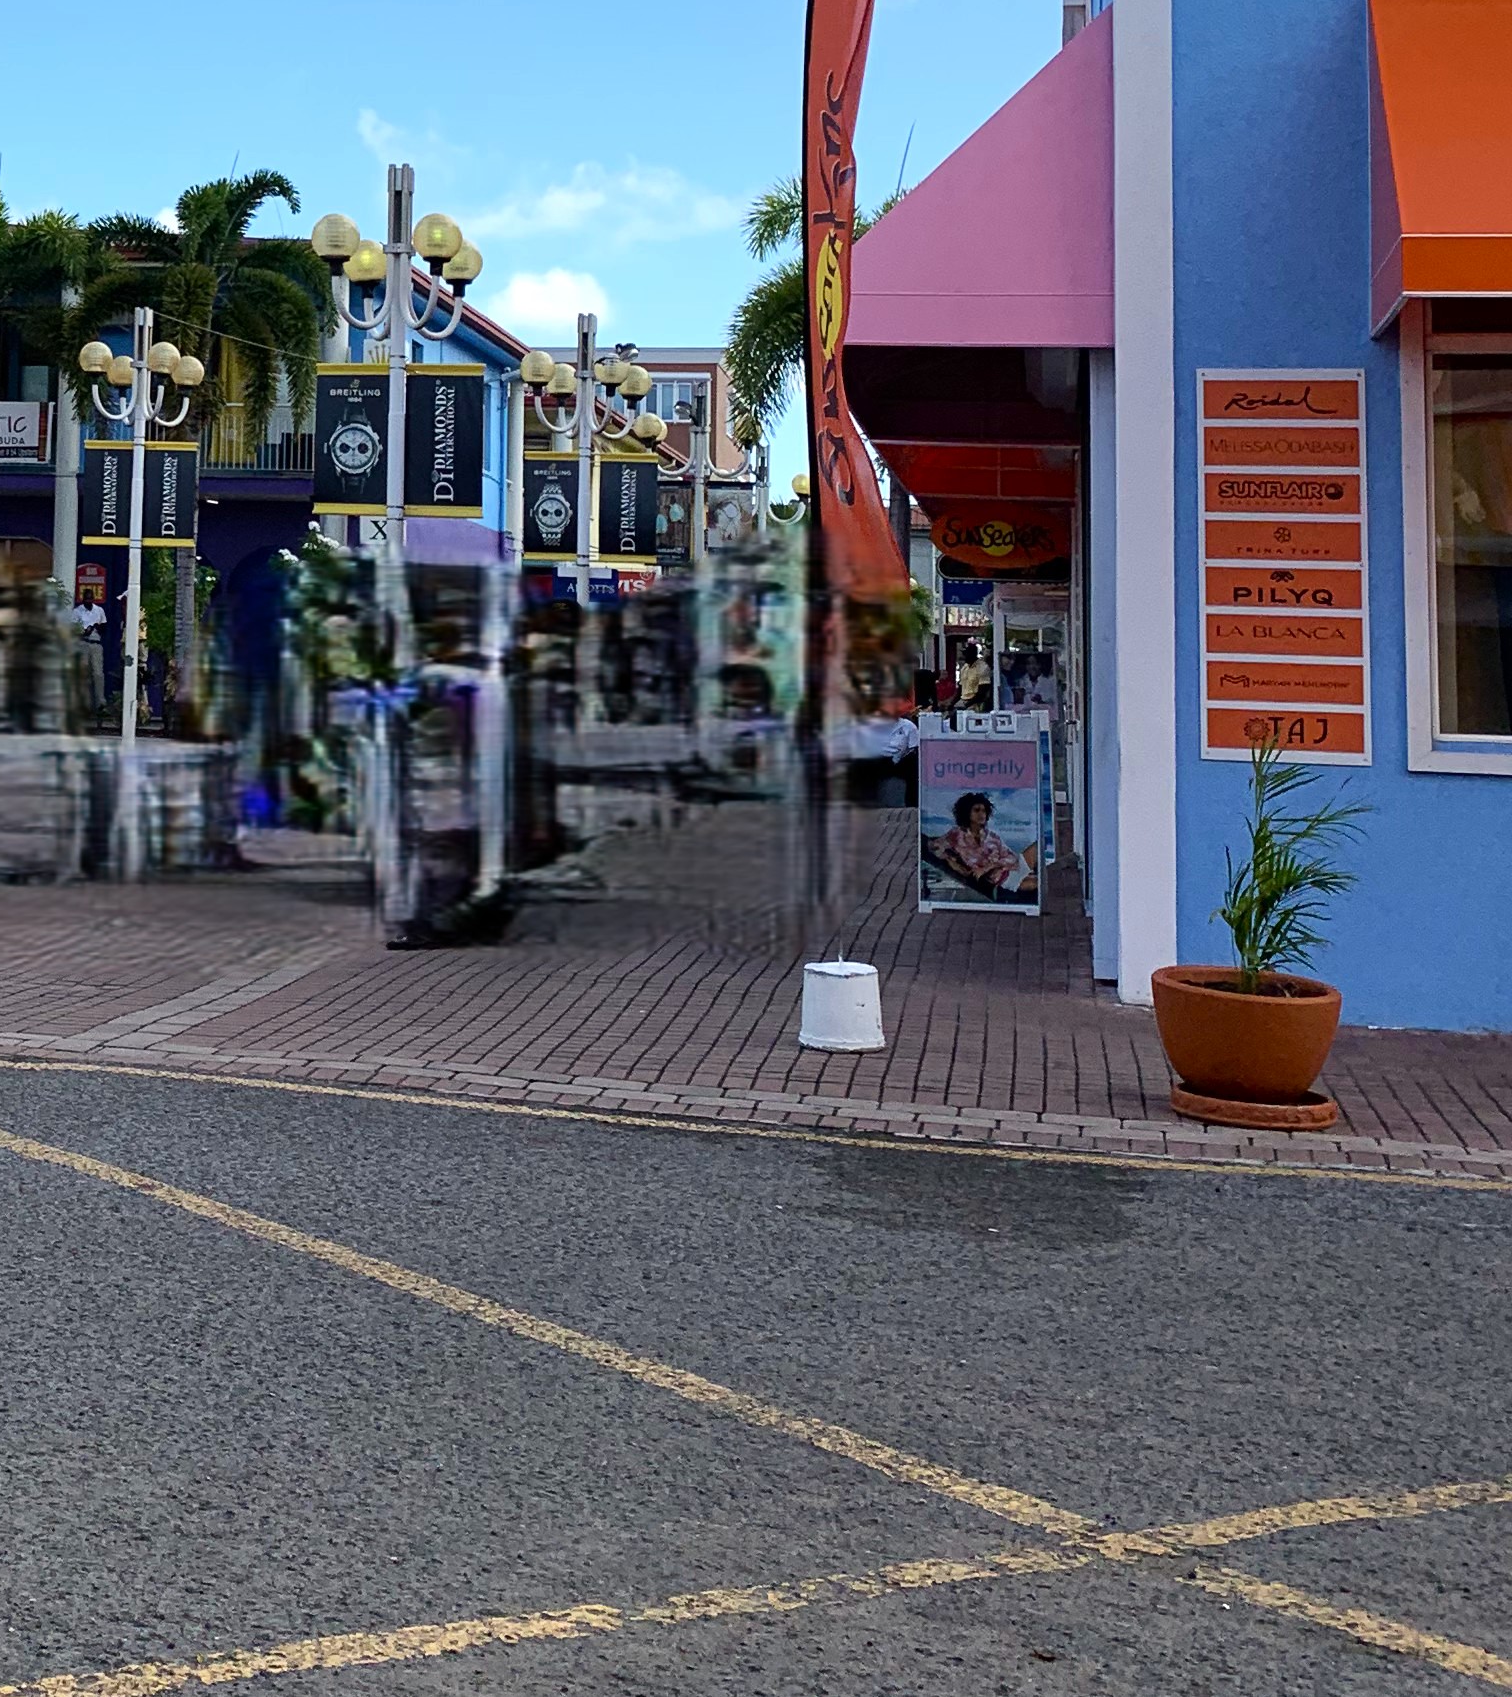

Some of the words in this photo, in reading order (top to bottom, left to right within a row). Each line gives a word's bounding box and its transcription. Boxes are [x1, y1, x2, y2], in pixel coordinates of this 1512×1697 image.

[329, 388, 381, 396] BREITLING
[434, 386, 447, 469] DIAMONDS
[445, 386, 456, 470] INTERNATIONAL
[103, 456, 112, 512] DIAMONDS
[110, 456, 118, 513] INTERNATIONAL
[162, 457, 172, 514] DIAMONDS
[1218, 480, 1323, 499] SUNFLAIR
[621, 469, 631, 529] DIAMONDS
[1237, 546, 1284, 554] TRINA
[1233, 586, 1333, 606] PILYQ
[1216, 624, 1244, 637] LA
[1252, 625, 1346, 640] BLANCA
[1267, 716, 1328, 744] TAJ
[934, 759, 1024, 779] gingerlily
